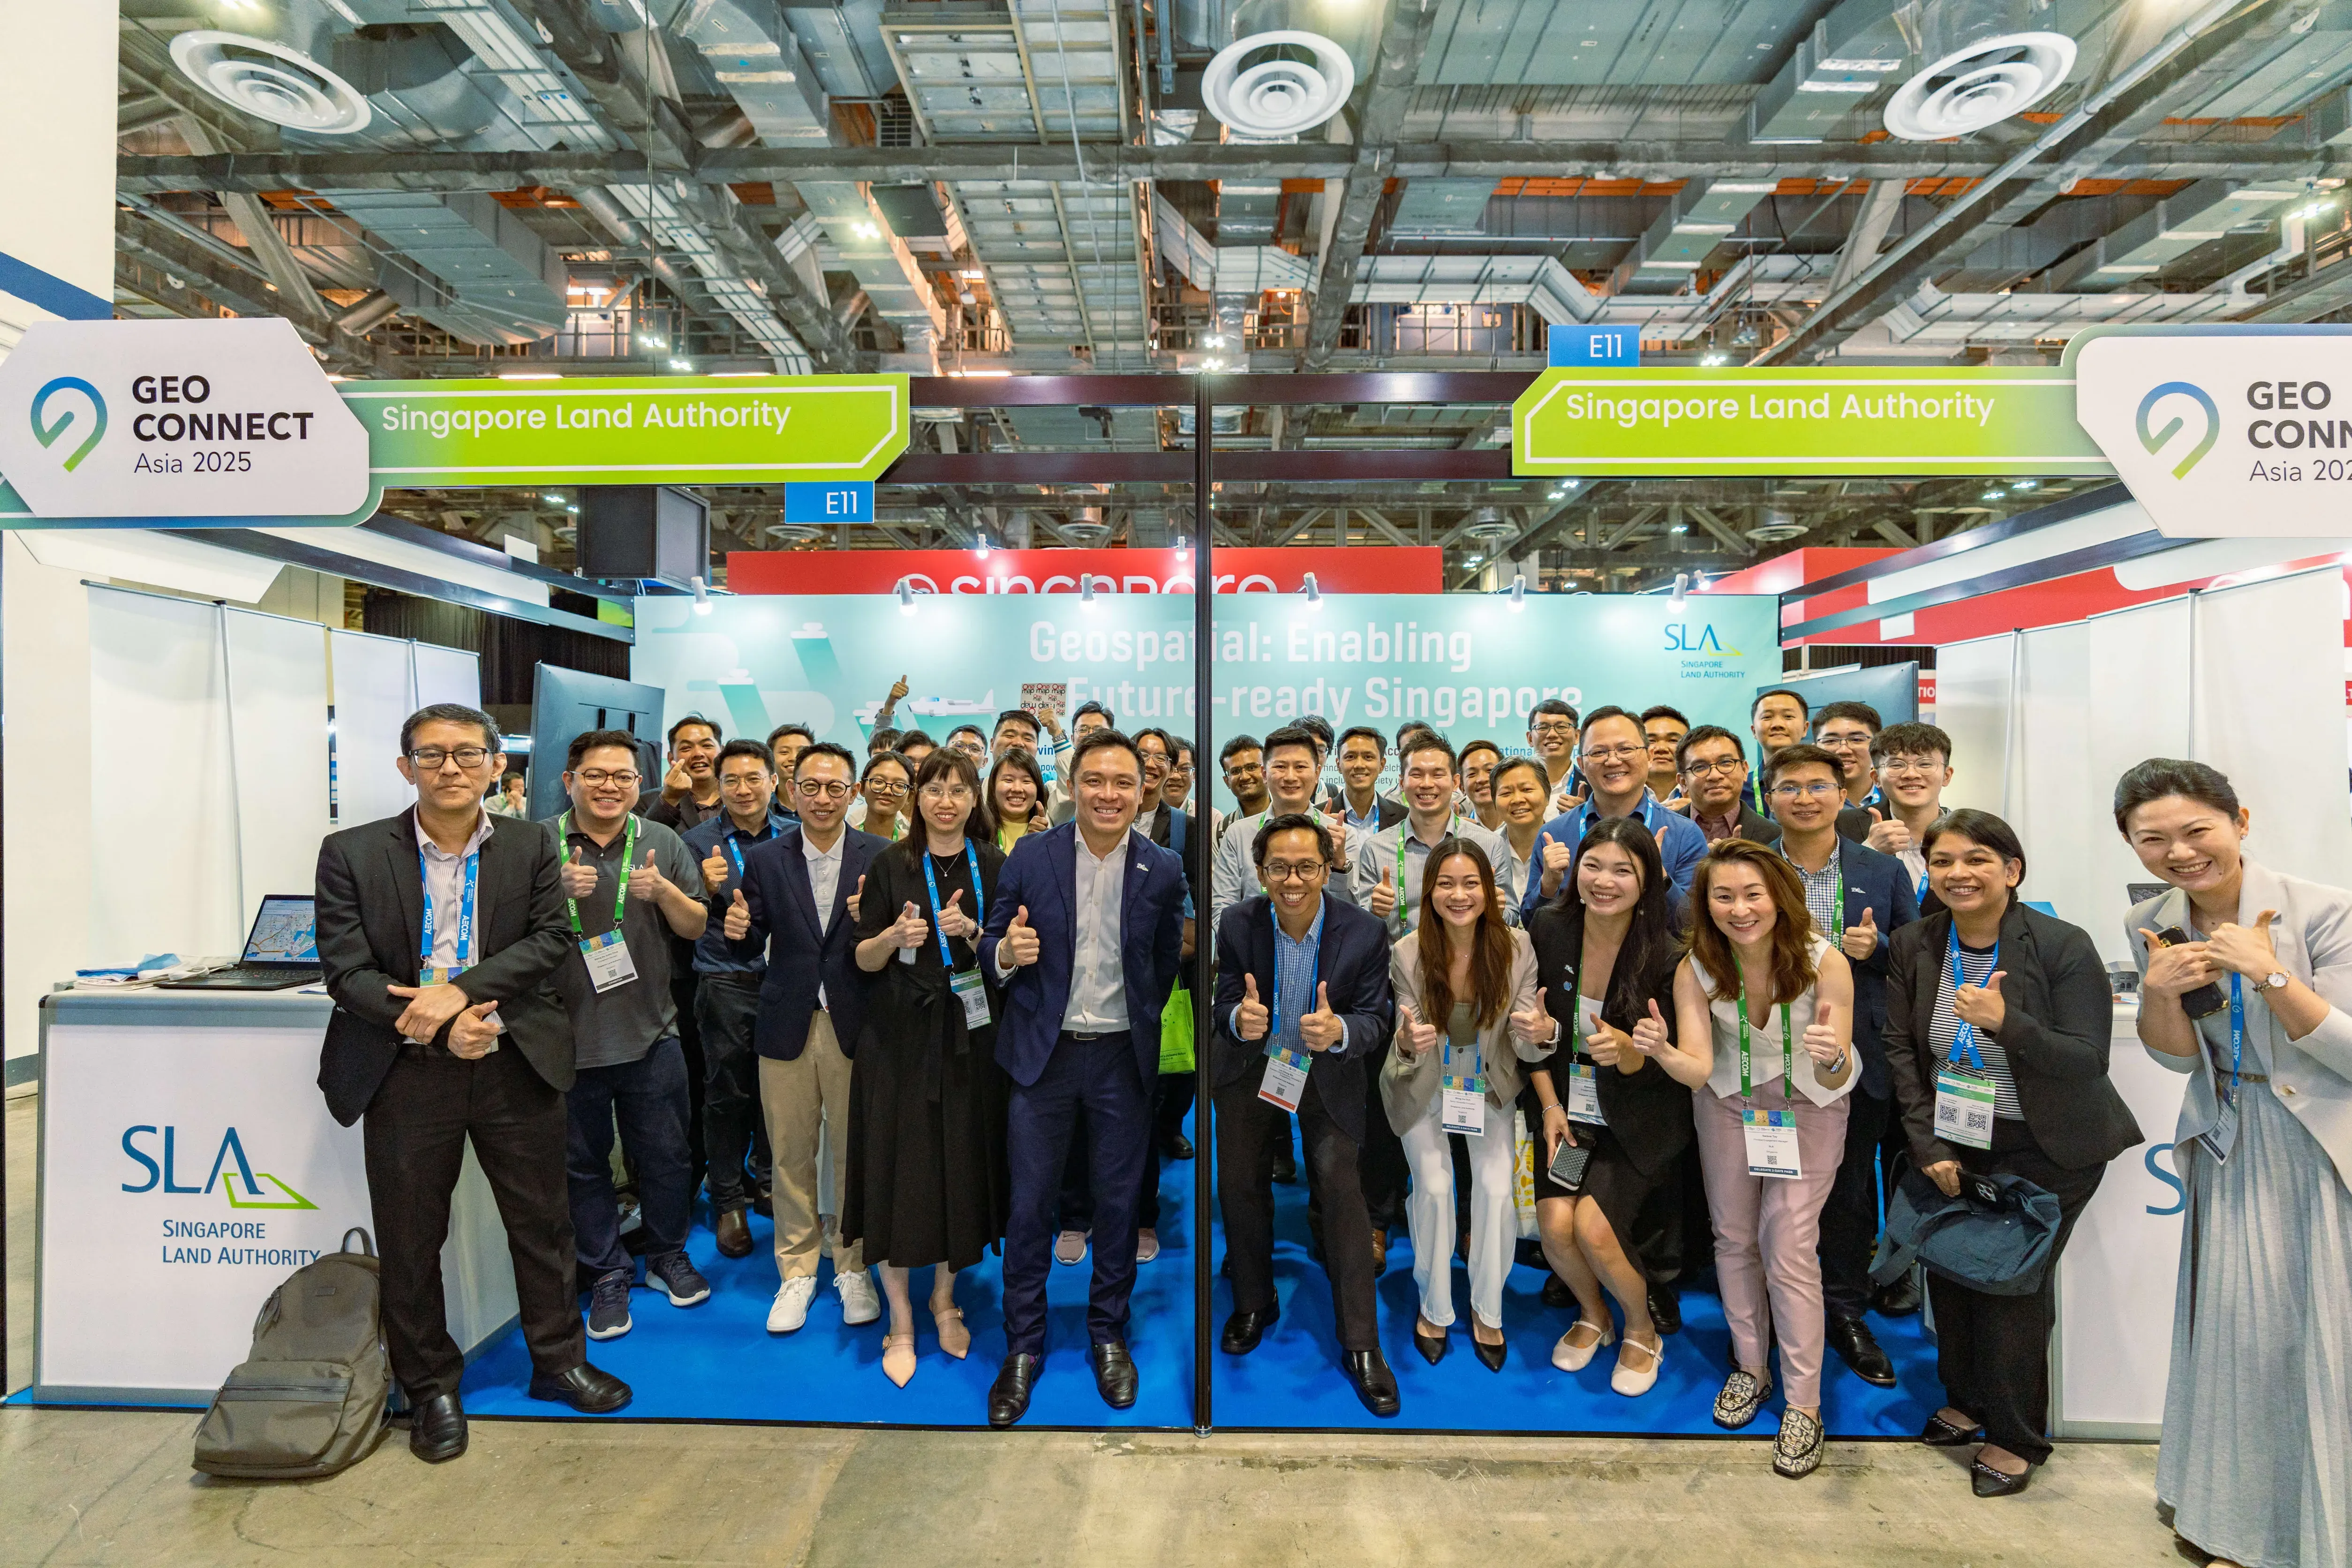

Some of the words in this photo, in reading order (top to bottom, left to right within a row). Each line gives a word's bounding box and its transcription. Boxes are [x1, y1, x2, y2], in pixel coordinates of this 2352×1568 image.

[1590, 334, 1622, 358] E11
[133, 375, 210, 404] GEO
[2247, 381, 2331, 410] GEO
[383, 405, 545, 438] Singapore
[557, 402, 632, 429] Land
[643, 400, 791, 435] Authority
[1566, 392, 1739, 428] Singapore
[1749, 392, 1830, 419] Land
[1840, 391, 1995, 426] Authority
[133, 412, 314, 442] CONNECT
[134, 453, 183, 474] Asia
[194, 452, 251, 472] 2025
[2249, 460, 2302, 482] Asia
[826, 491, 859, 514] E11
[1288, 621, 1471, 672] Enabling
[1665, 624, 1723, 651] SLA
[1068, 677, 1351, 727] Future-ready
[1365, 677, 1583, 727] Singapore
[618, 883, 626, 904] AECOM
[460, 915, 470, 941] AECOM
[122, 1125, 265, 1195] SLA
[163, 1219, 266, 1239] SINGAPORE
[163, 1246, 212, 1265] LAND
[218, 1246, 321, 1266] AUTHORITY
